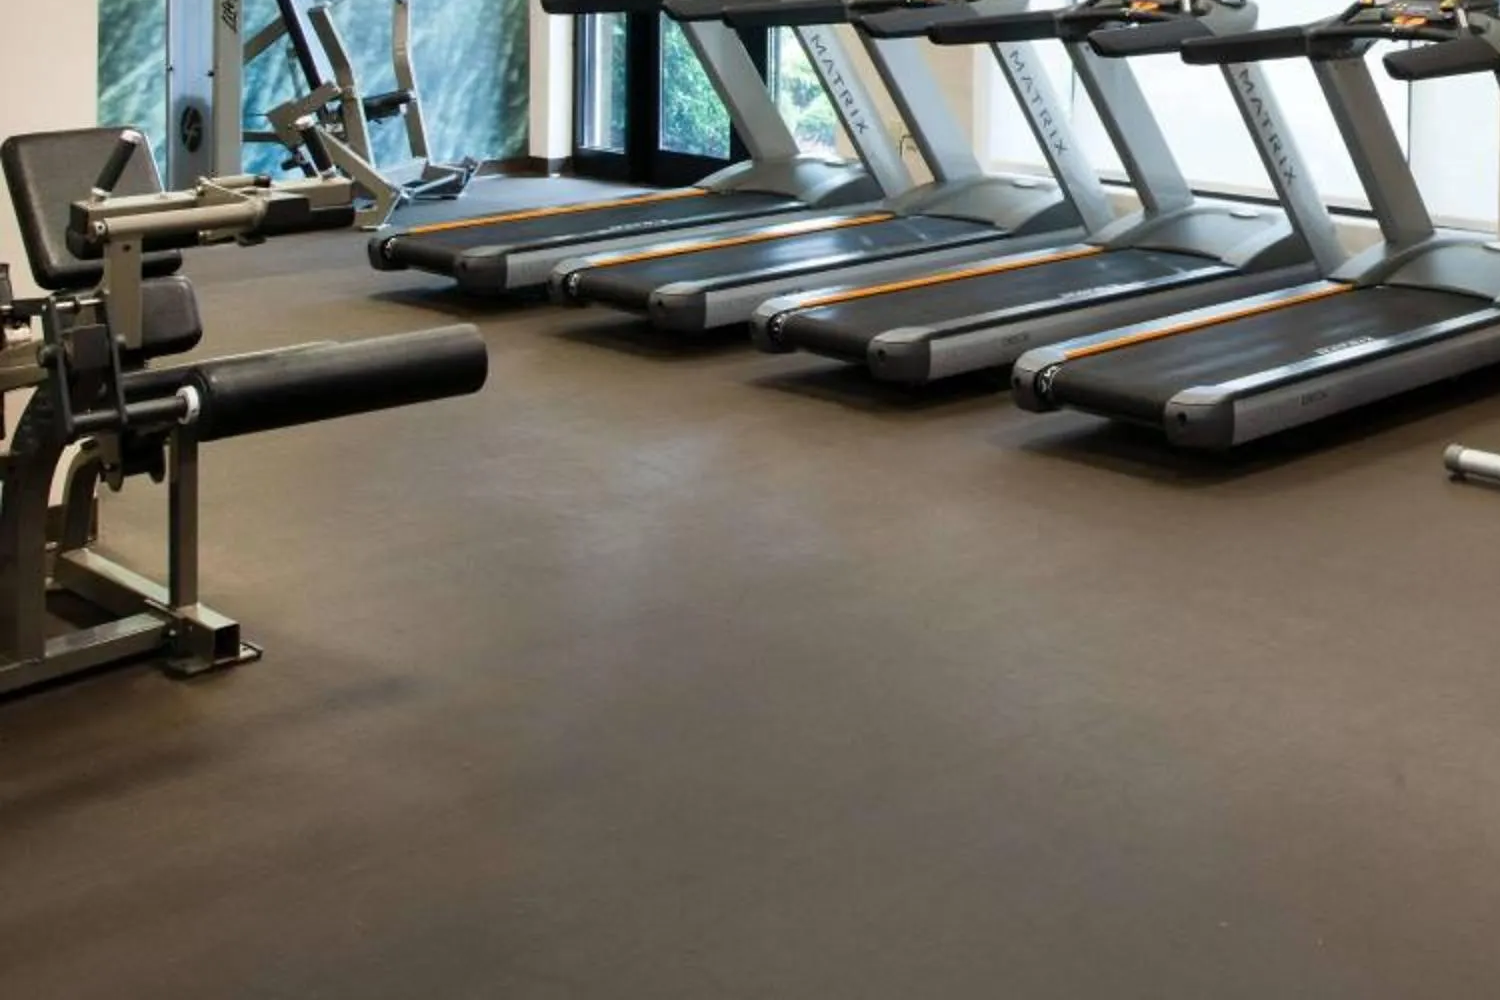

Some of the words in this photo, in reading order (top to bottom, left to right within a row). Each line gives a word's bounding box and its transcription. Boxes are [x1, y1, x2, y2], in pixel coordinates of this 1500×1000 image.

[811, 34, 870, 134] MATRIX
[1009, 50, 1068, 157] MATRIX
[1239, 67, 1297, 187] MATRIX
